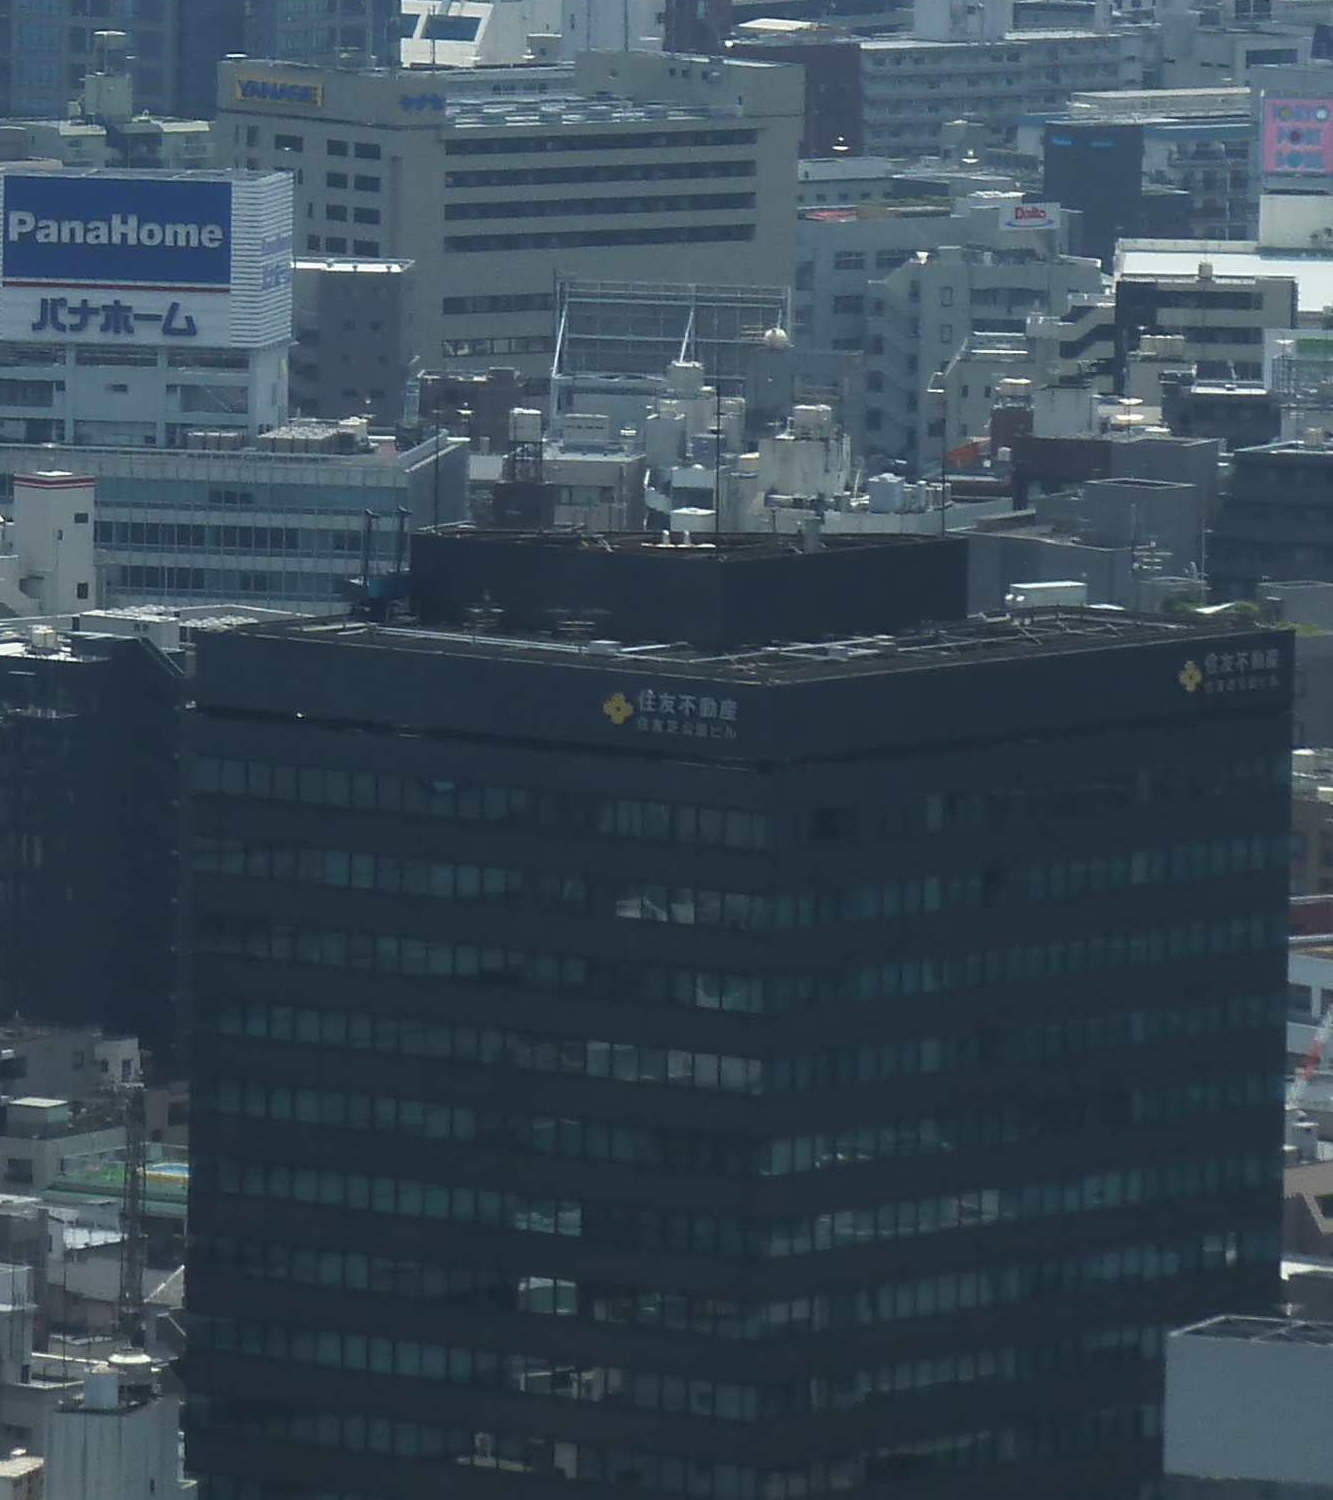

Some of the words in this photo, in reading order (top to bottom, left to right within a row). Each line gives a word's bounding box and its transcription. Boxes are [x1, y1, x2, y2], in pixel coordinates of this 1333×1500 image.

[237, 79, 319, 106] YANASE
[8, 210, 223, 248] PanaHome
[32, 297, 197, 336] パナホーム
[638, 689, 738, 721] 住友不動産
